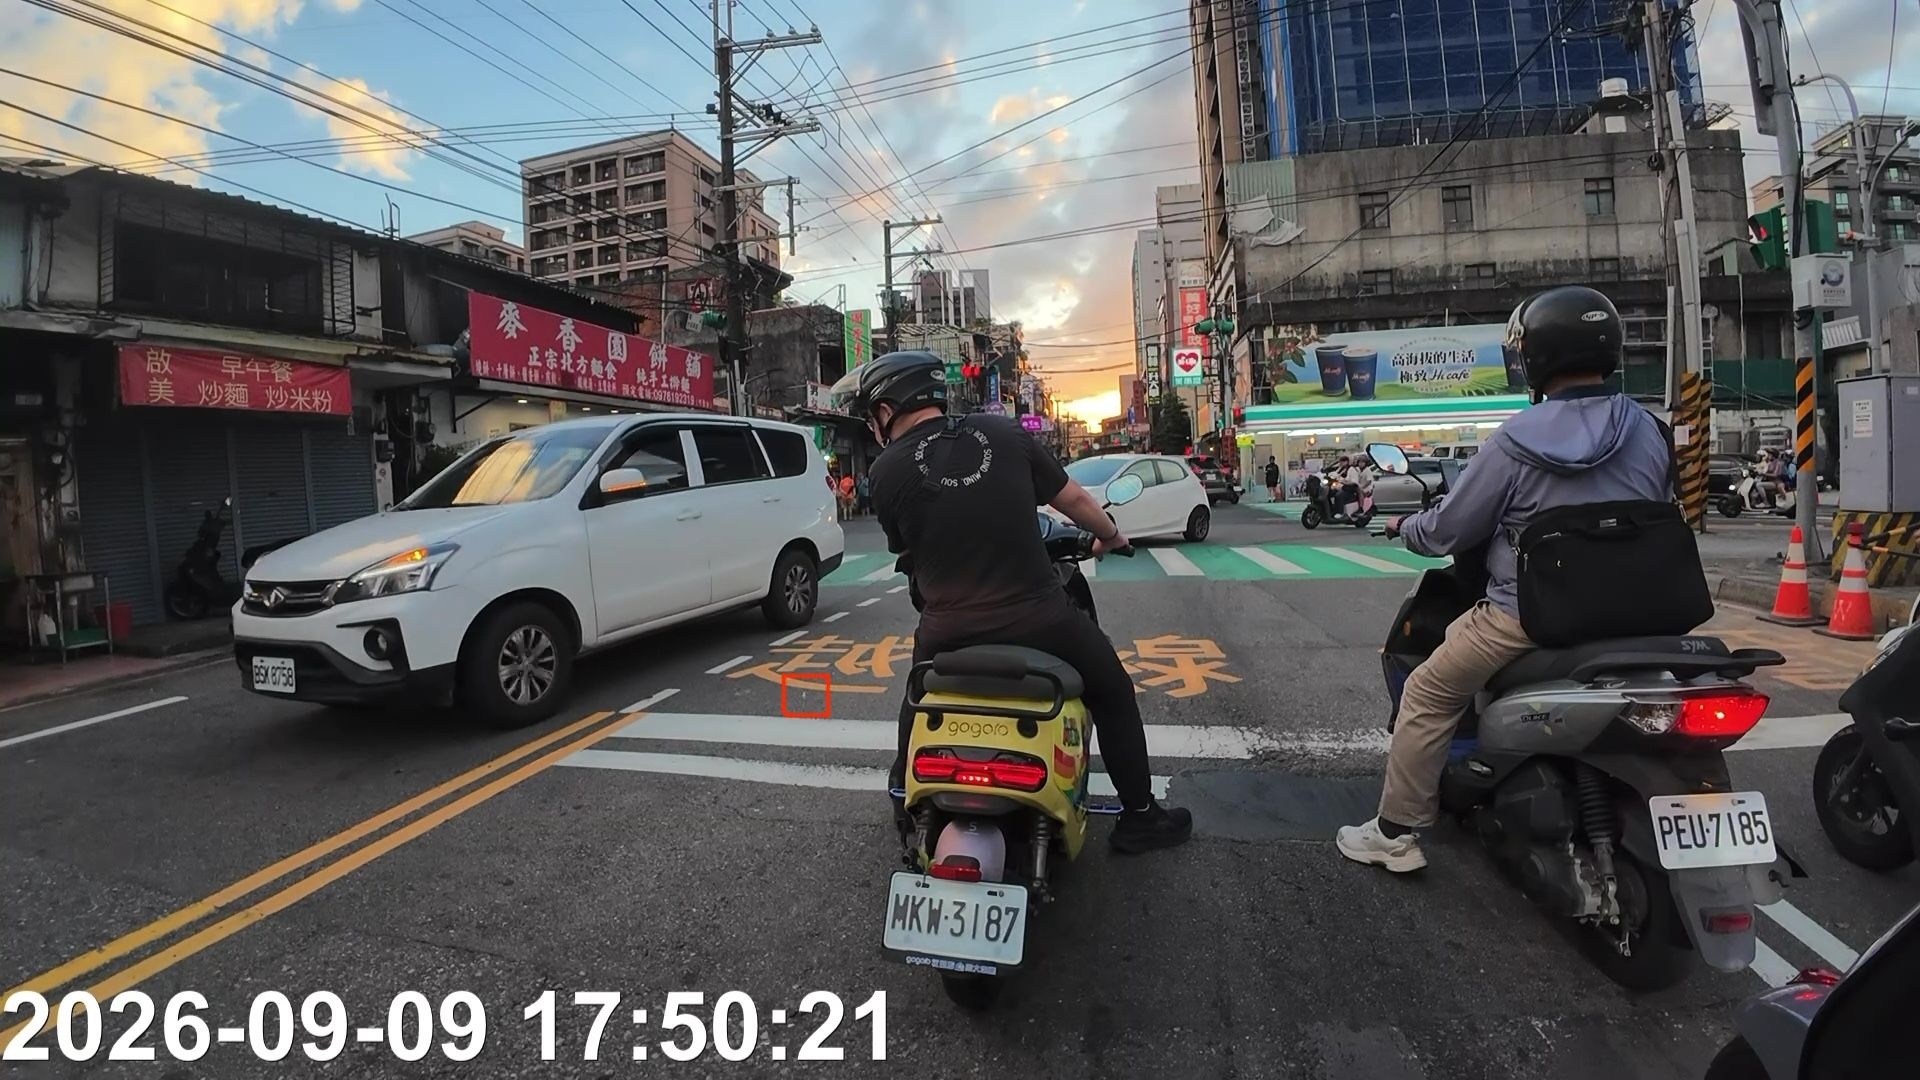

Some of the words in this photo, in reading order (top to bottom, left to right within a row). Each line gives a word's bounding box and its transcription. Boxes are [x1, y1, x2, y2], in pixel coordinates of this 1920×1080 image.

[1392, 349, 1475, 367] 高海拔的生活
[221, 356, 293, 384] 早午餐
[198, 380, 249, 409] 炒麵
[265, 386, 333, 413] 炒米粉
[1681, 640, 1711, 653] SYM
[948, 720, 1009, 738] gogoro
